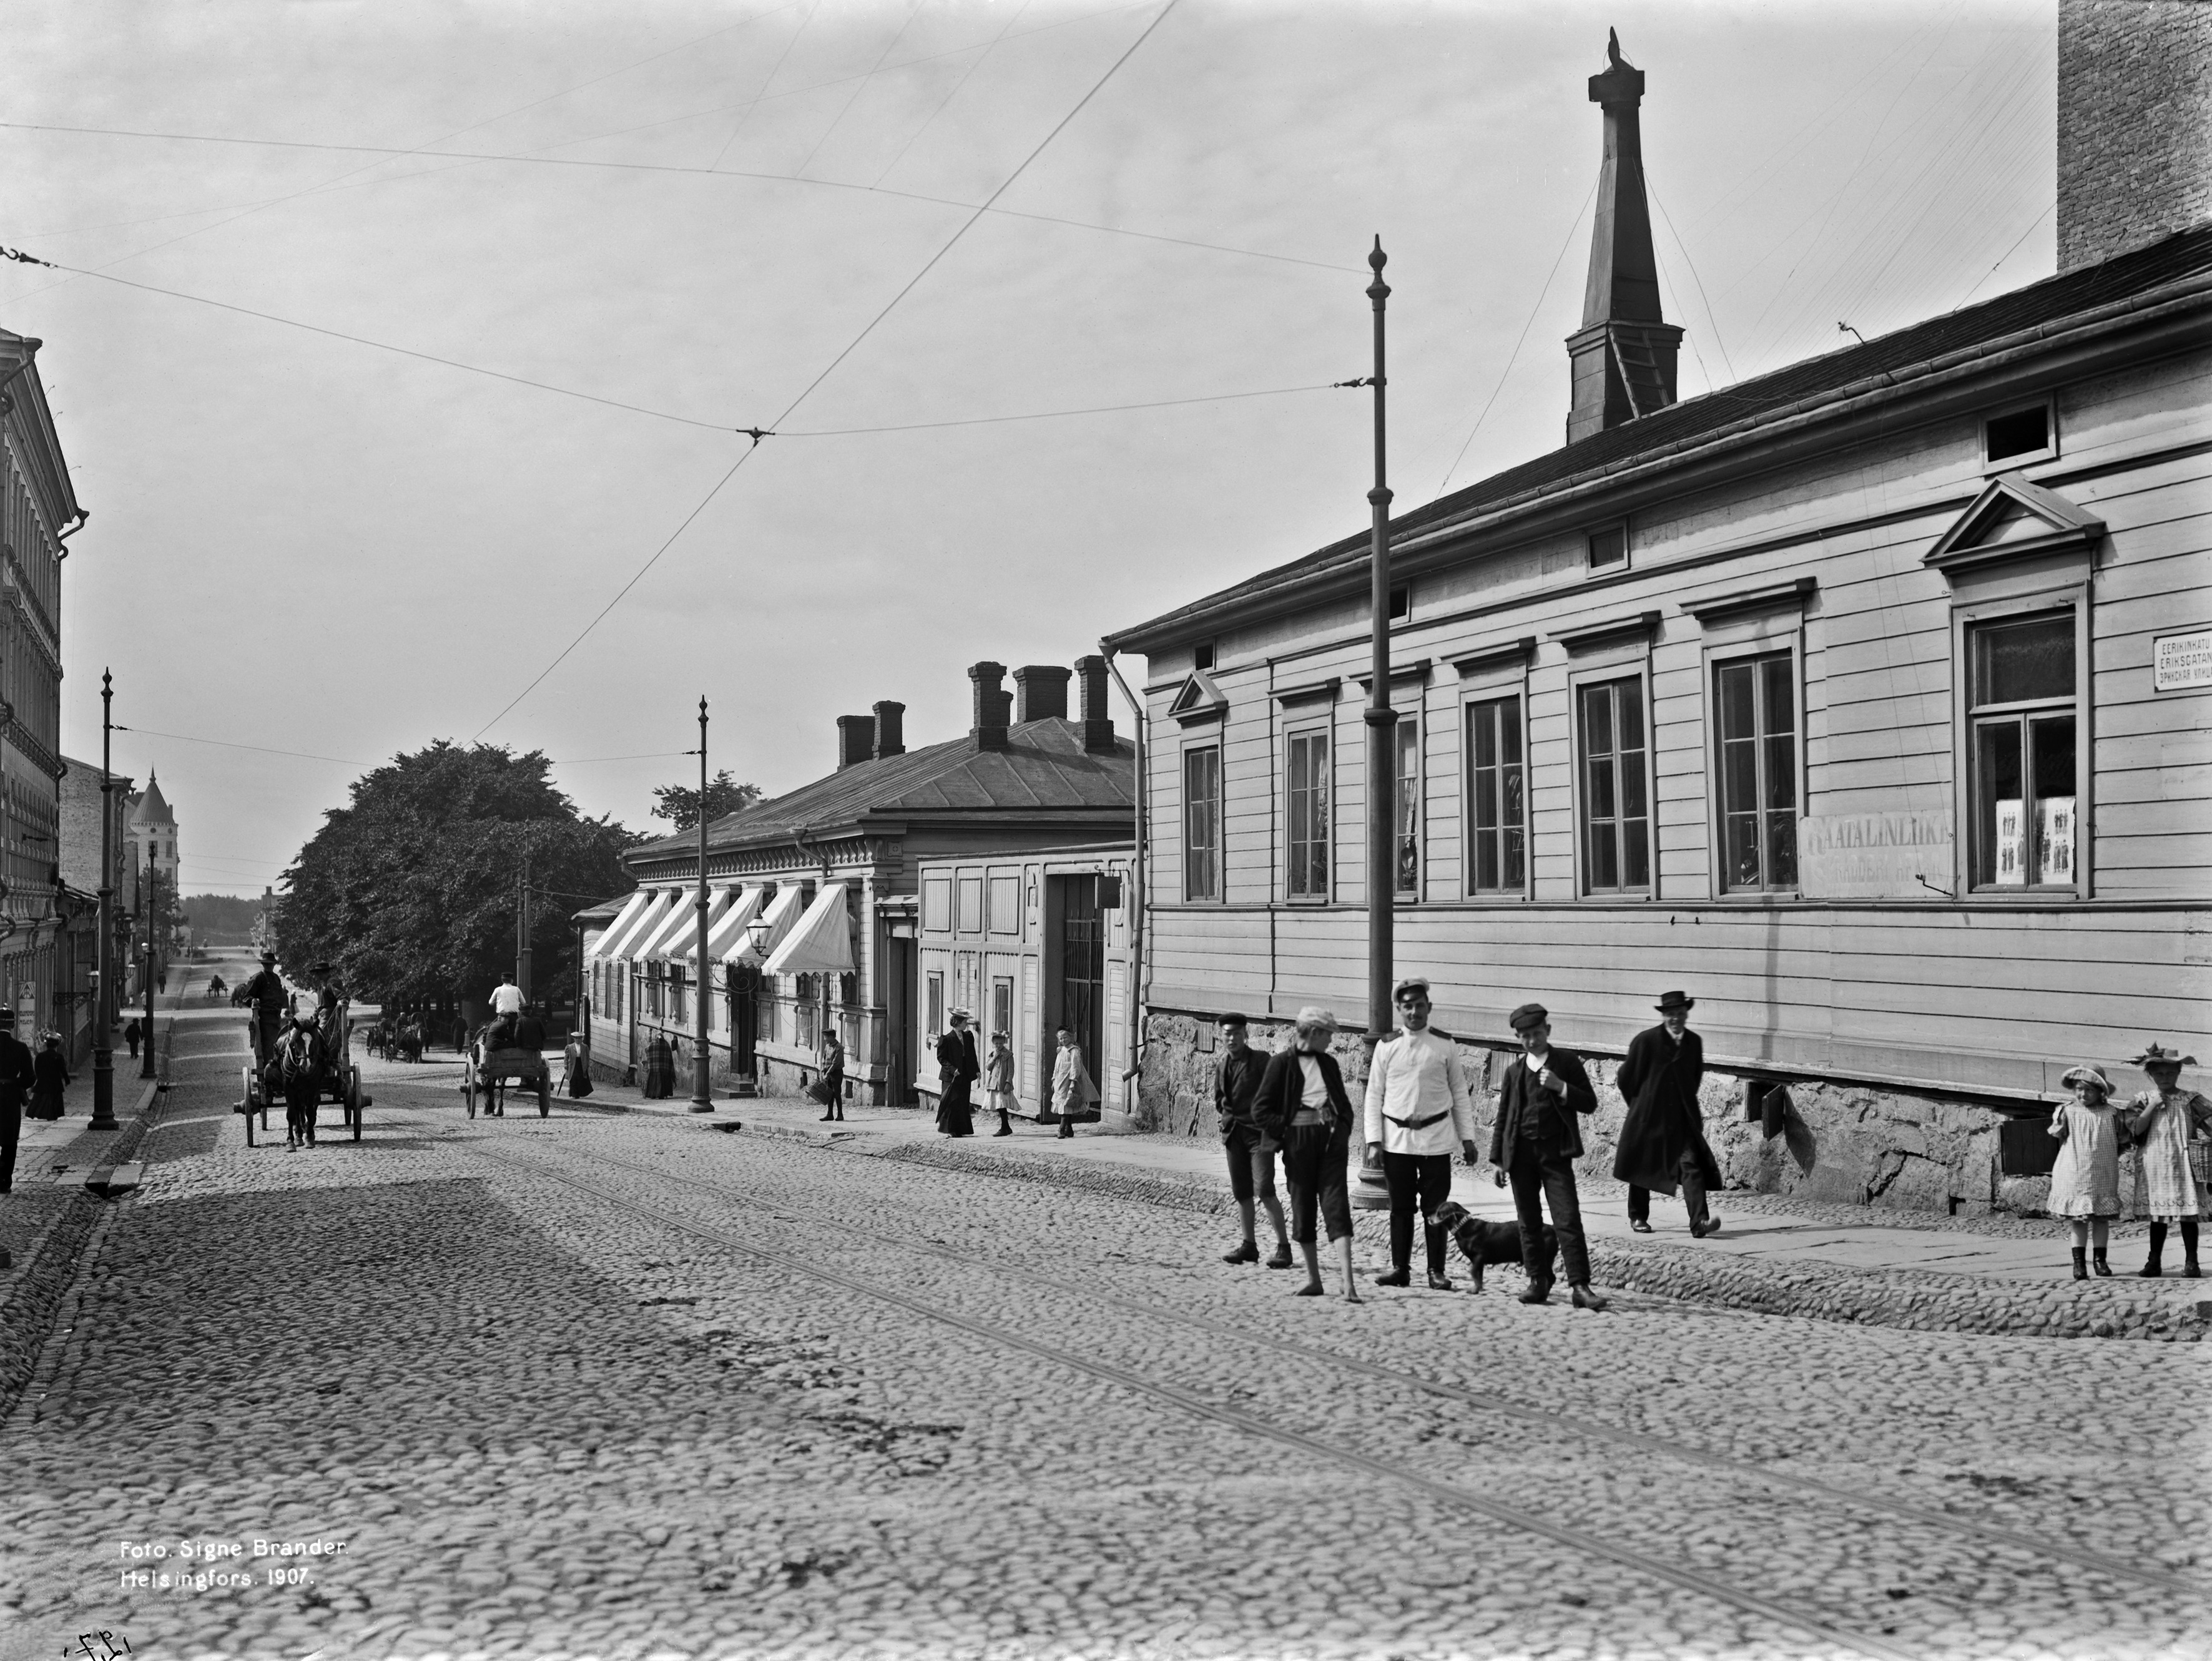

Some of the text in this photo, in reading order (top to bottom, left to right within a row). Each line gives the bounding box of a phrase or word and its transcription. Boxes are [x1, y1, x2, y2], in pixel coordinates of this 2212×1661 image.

[2163, 639, 2210, 655] EERIKINKATU
[2161, 652, 2212, 669] ERIKSGATAN
[2194, 667, 2212, 679] УЛИЦ
